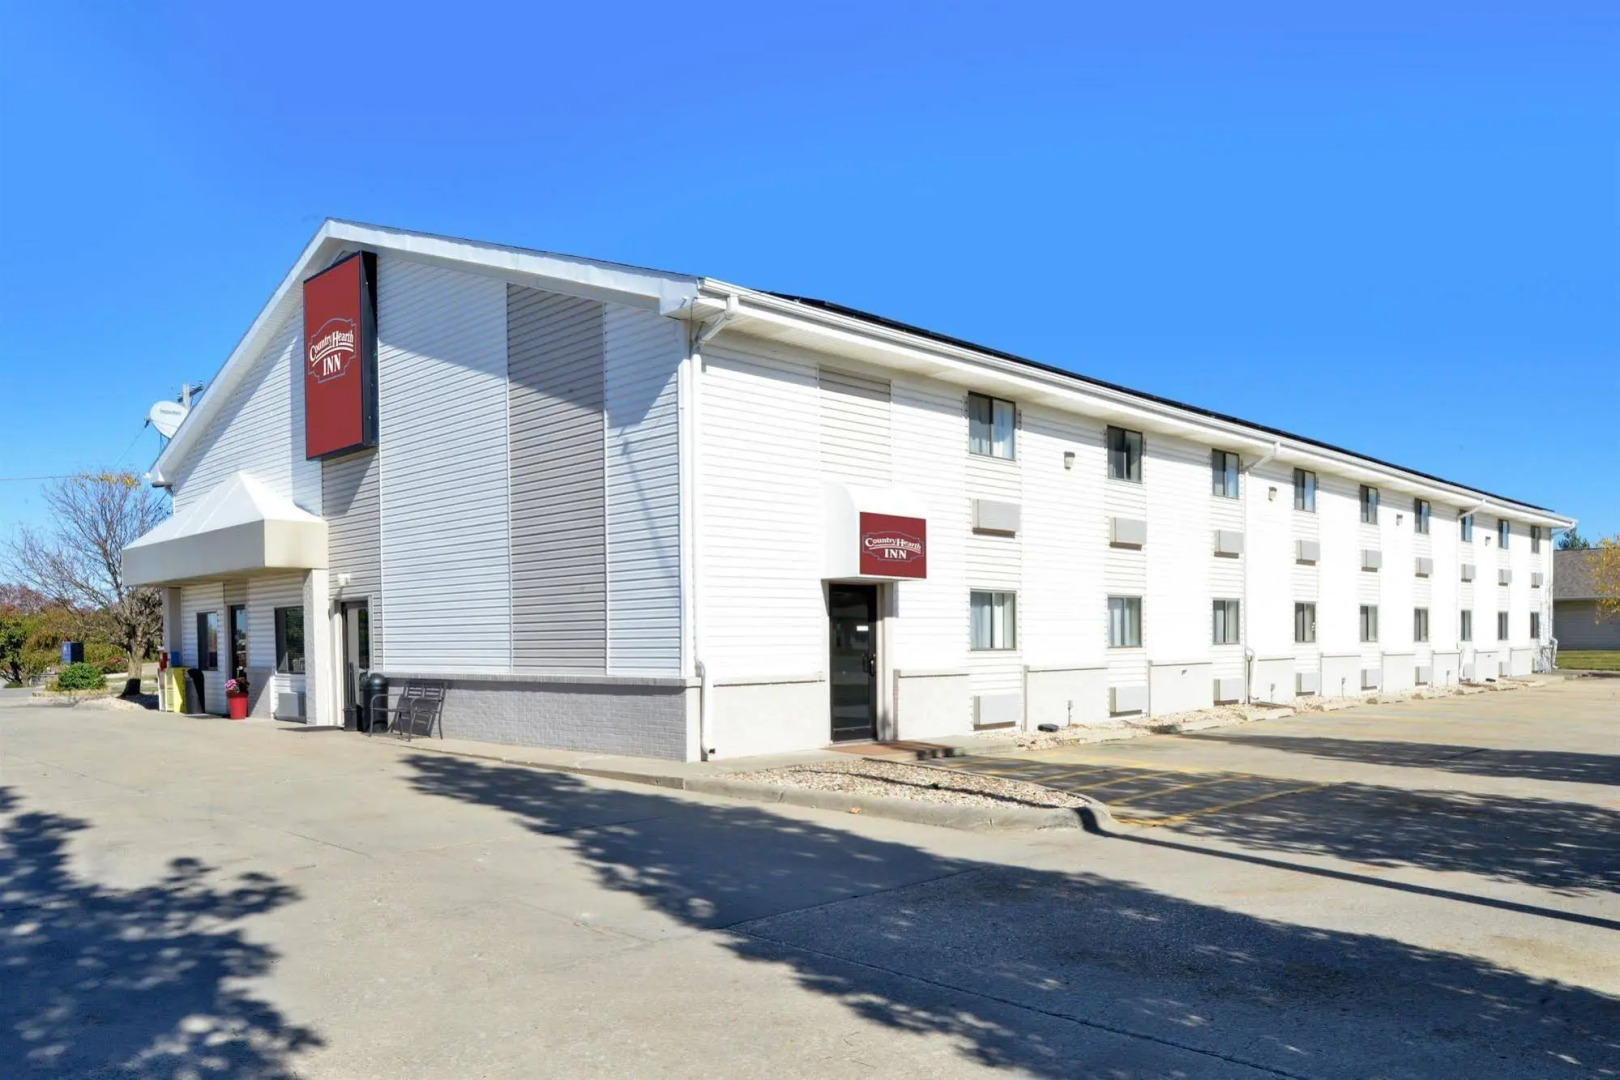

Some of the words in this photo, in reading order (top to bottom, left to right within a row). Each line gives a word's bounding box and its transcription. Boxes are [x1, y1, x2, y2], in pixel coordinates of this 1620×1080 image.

[310, 334, 332, 362] Country
[332, 330, 354, 347] Hearth
[323, 353, 341, 376] INN
[865, 537, 896, 547] Country
[896, 538, 921, 550] Hearth
[884, 548, 907, 559] INN
